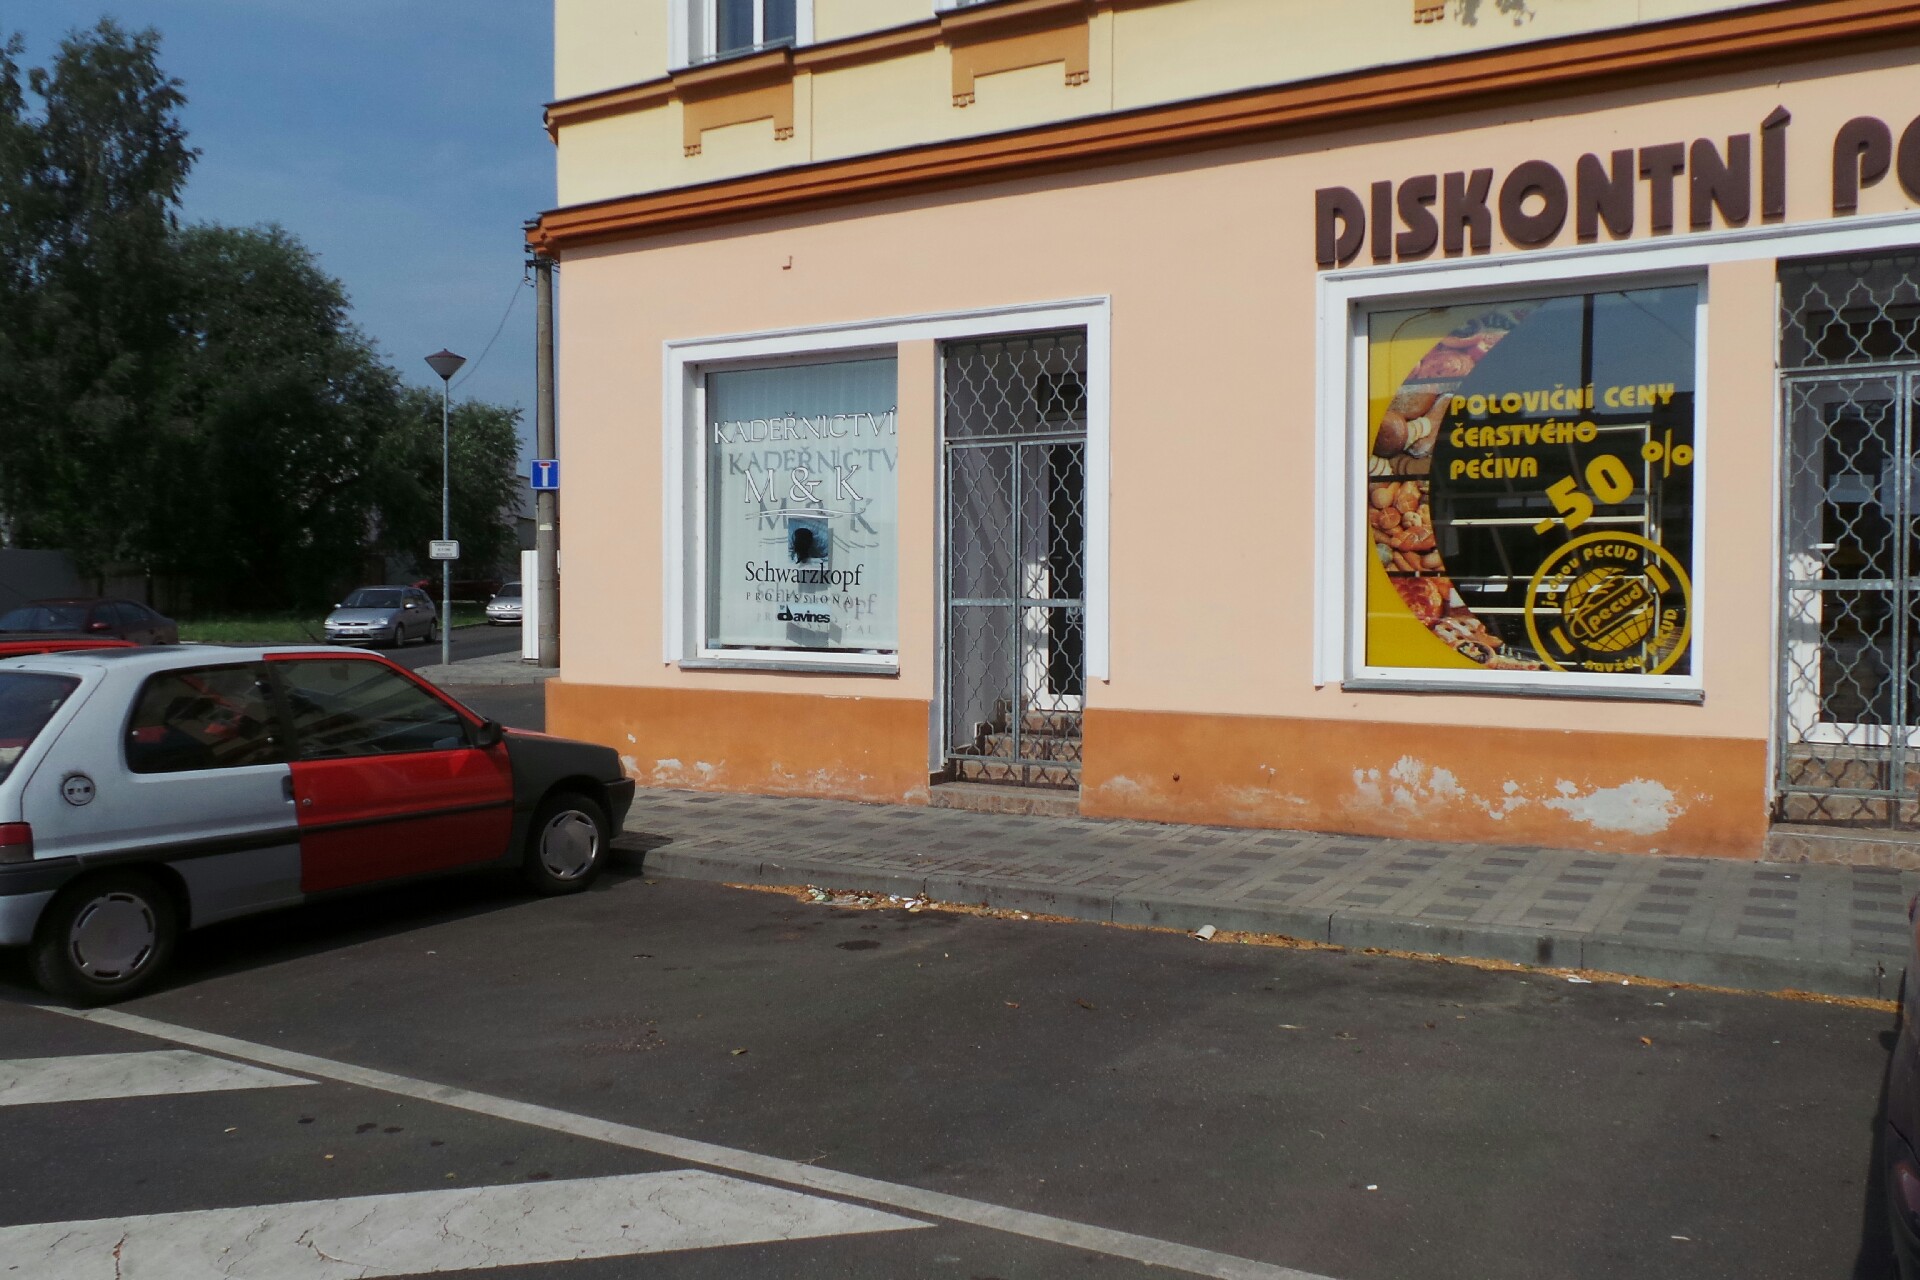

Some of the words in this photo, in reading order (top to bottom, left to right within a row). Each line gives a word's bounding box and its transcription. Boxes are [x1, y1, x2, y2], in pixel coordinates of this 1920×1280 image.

[1315, 104, 1791, 267] DISKONTNÍ
[1450, 382, 1595, 416] POLOVIČNÍ
[1604, 383, 1675, 408] CENY
[713, 405, 896, 444] KADEŘNICTVÍ
[1450, 418, 1598, 448] ČERSTVÉHO
[1450, 453, 1539, 480] PEČIVA
[744, 468, 778, 503] M
[789, 466, 822, 503] &
[834, 464, 863, 502] K
[745, 560, 864, 593] Schwarzkopf
[746, 592, 861, 606] PROFESSIONAL
[777, 604, 831, 624] davines
